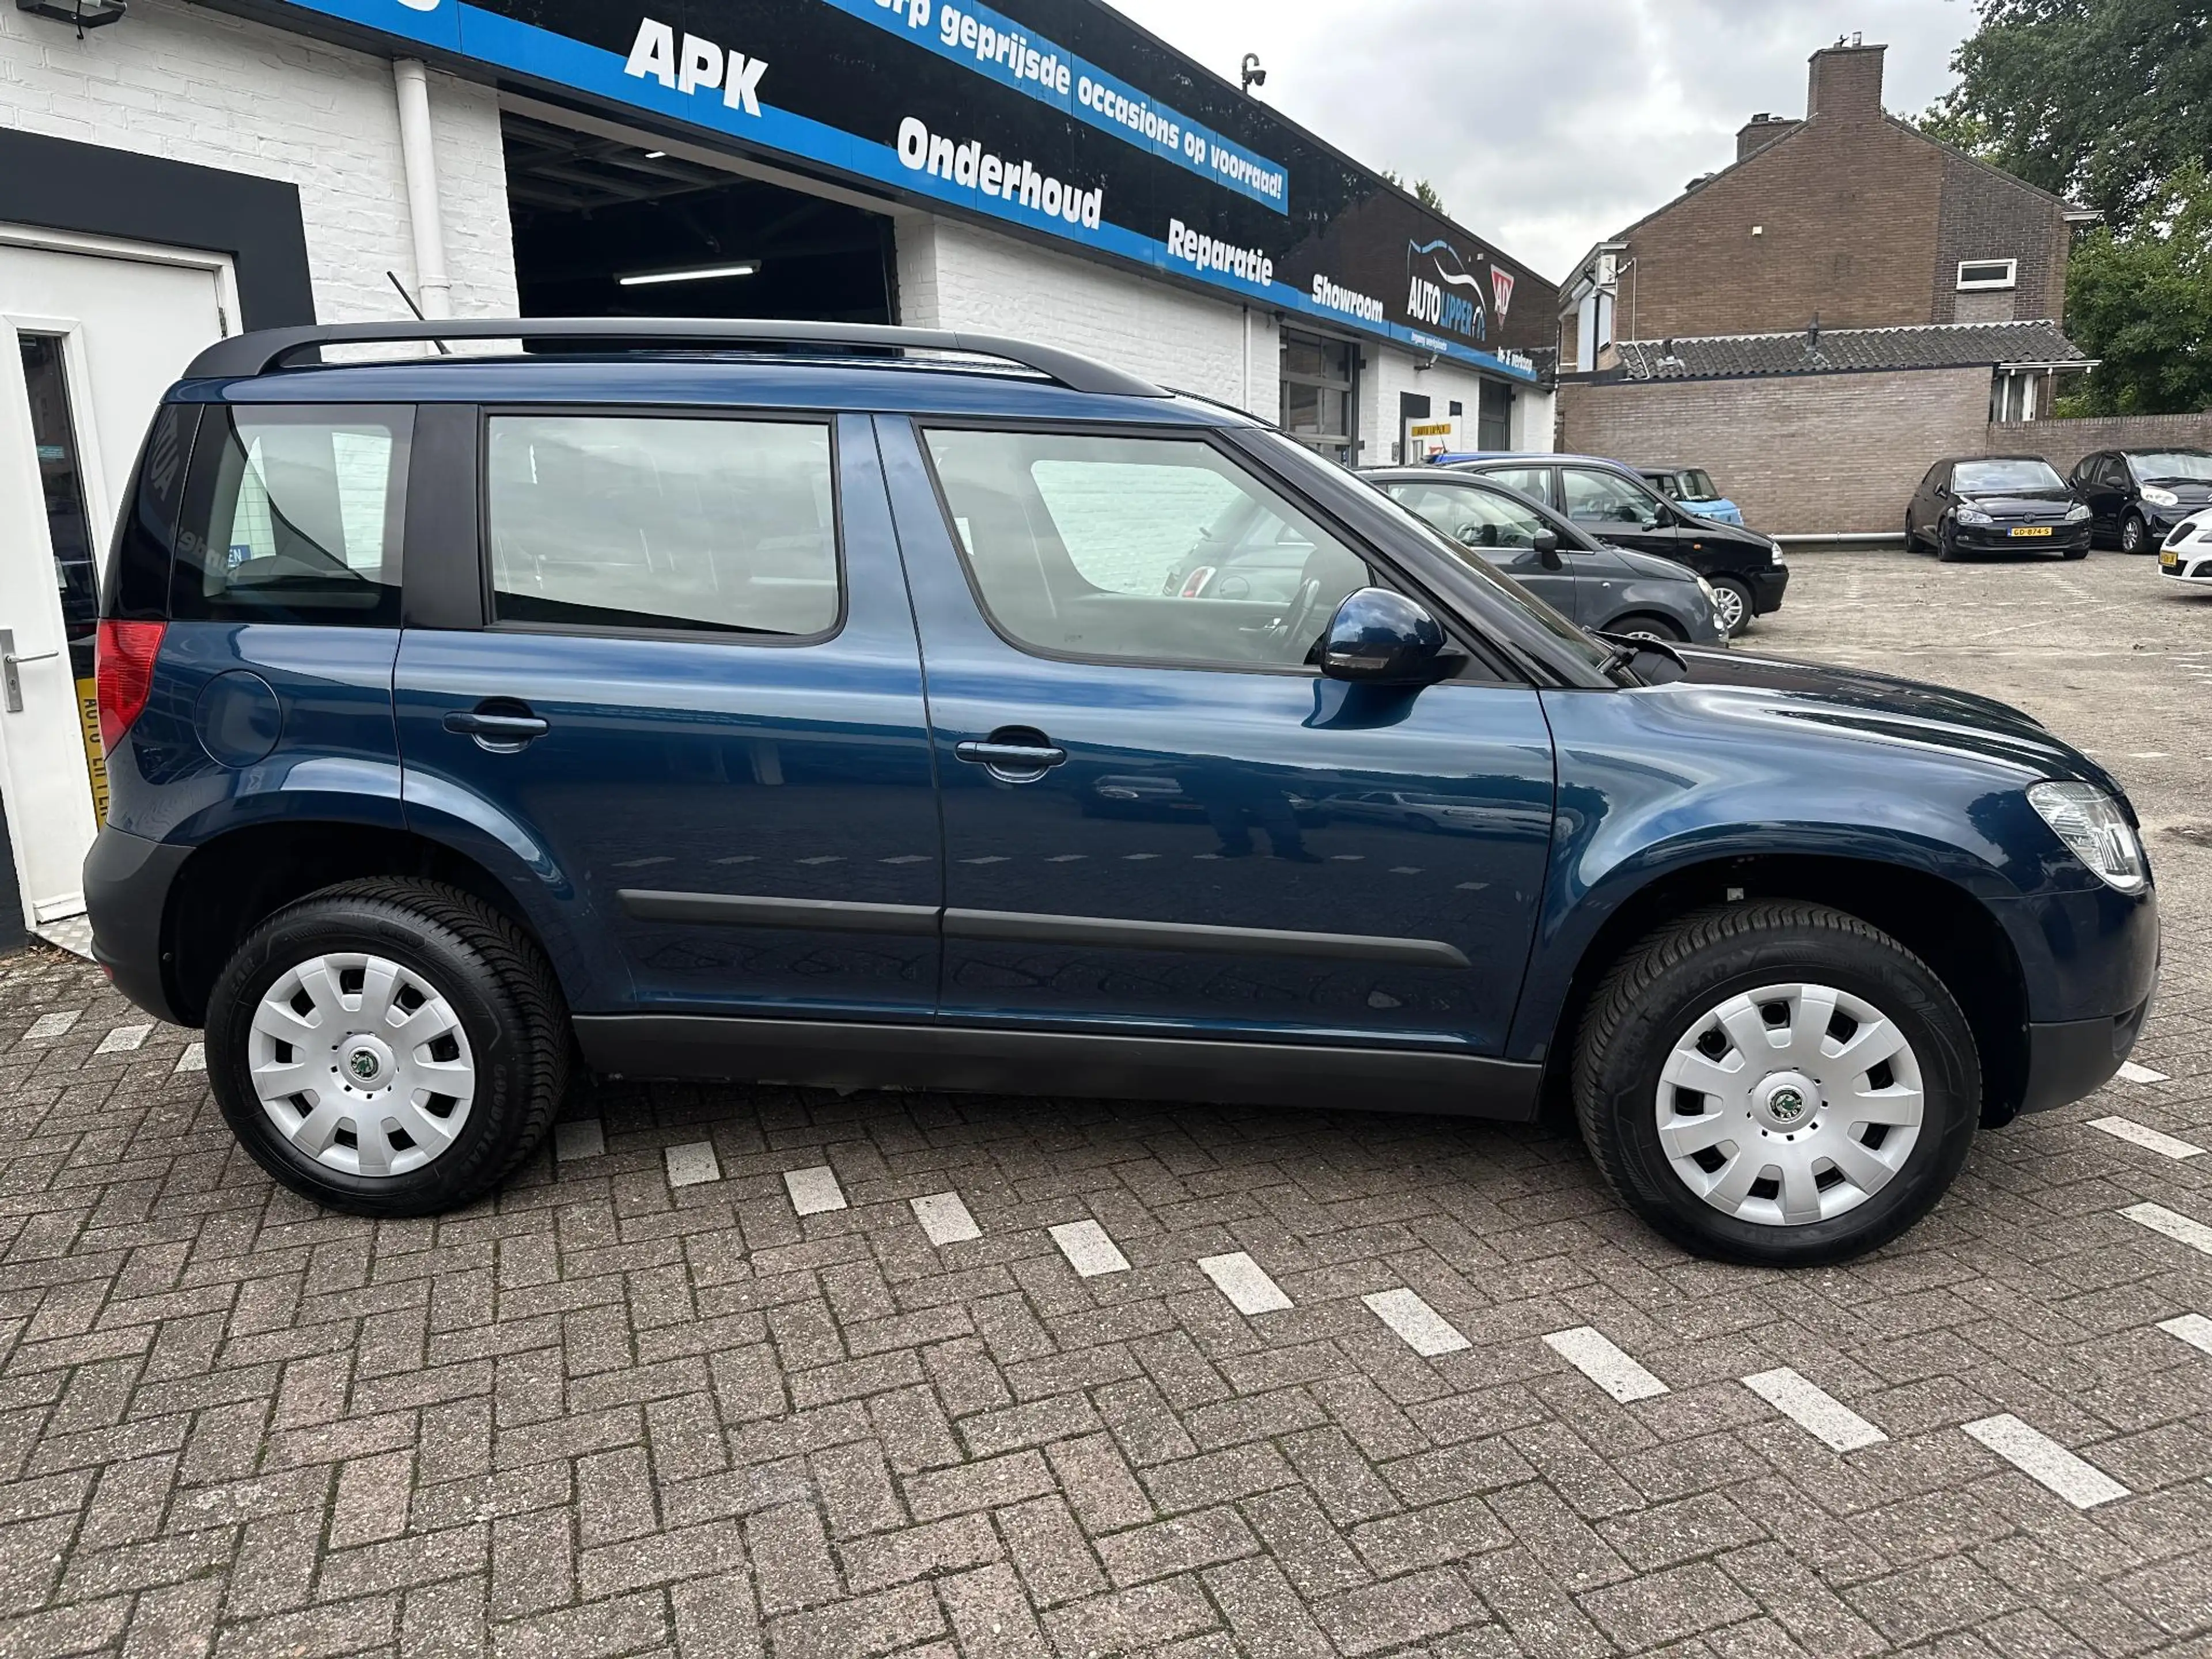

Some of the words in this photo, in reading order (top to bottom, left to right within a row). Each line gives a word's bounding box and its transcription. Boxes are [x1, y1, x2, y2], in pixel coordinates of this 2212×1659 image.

[624, 17, 769, 118] APK
[940, 4, 1071, 94] geprijsde
[1078, 76, 1180, 149] occasions
[1184, 131, 1206, 165] op
[1211, 145, 1282, 199] voorraad!
[897, 116, 1103, 230] Onderhoud
[1167, 218, 1273, 286] Reparatie
[1312, 274, 1383, 324] Showroom
